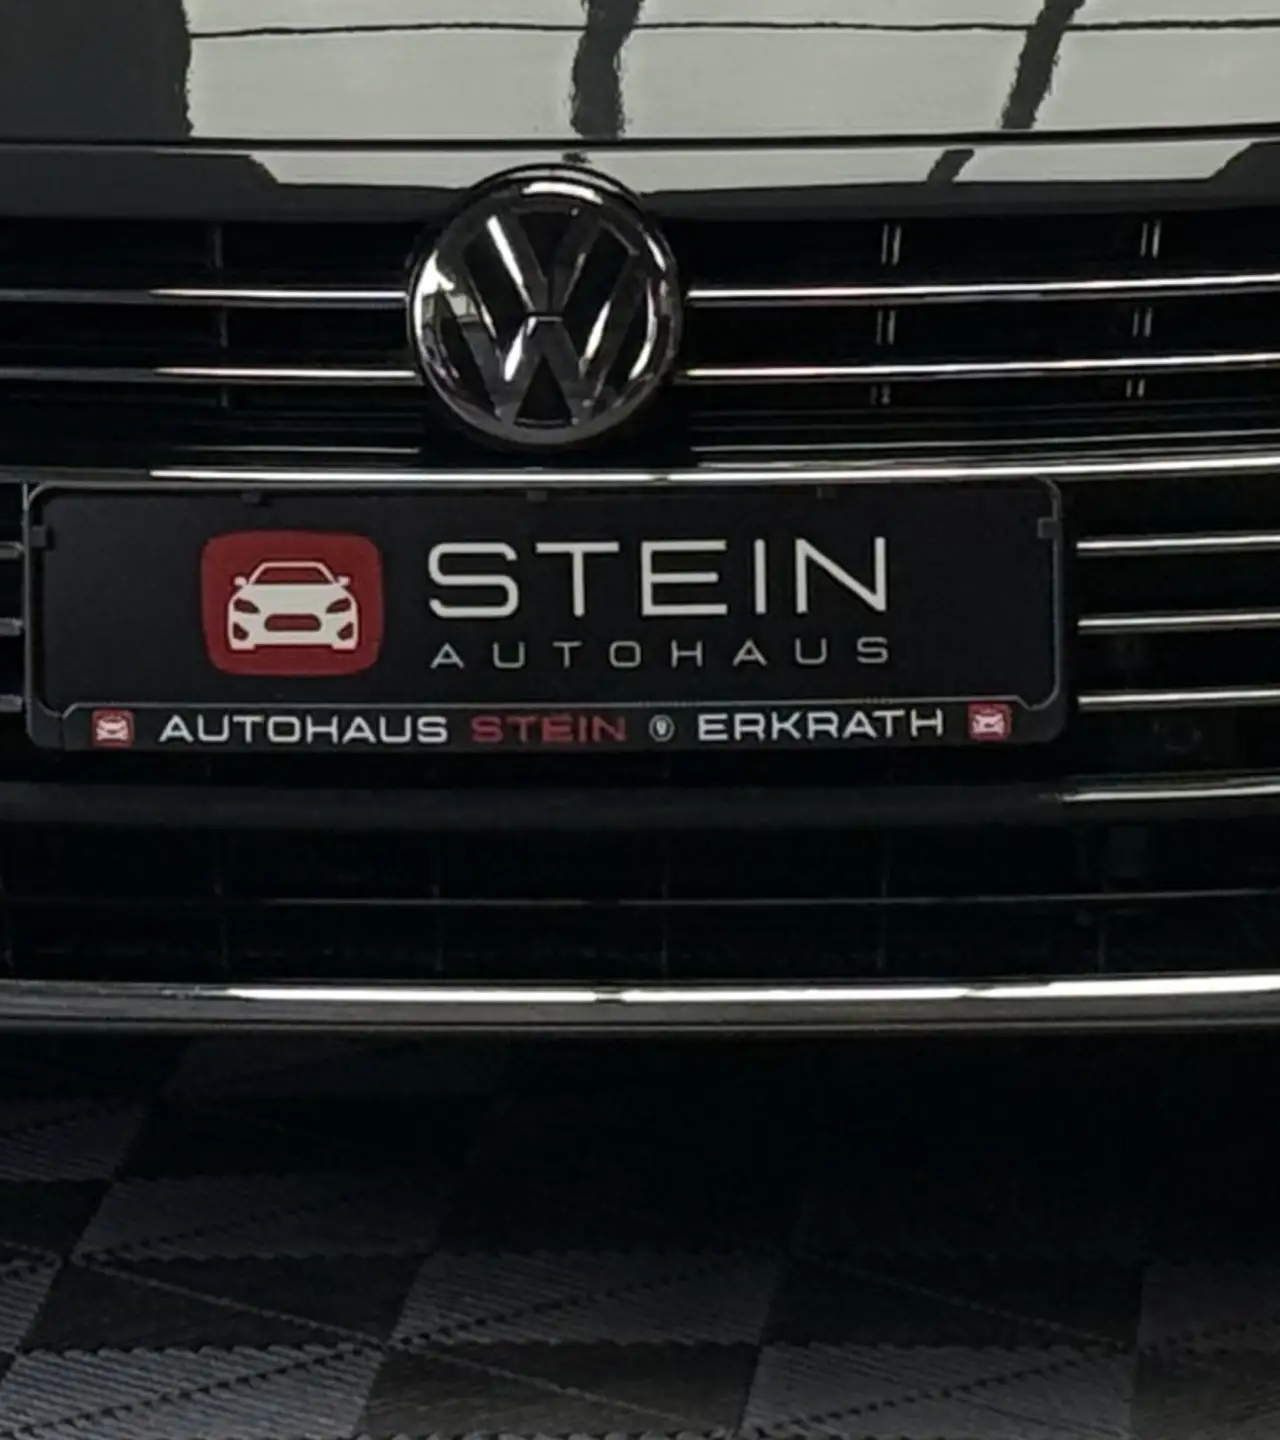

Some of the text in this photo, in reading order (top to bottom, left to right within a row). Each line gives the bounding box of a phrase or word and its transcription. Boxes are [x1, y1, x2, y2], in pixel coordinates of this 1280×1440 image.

[427, 536, 888, 619] STEIN
[430, 636, 889, 669] AUTOHAUS
[159, 709, 943, 744] AUTOHAUS STEIN ERKRATH
